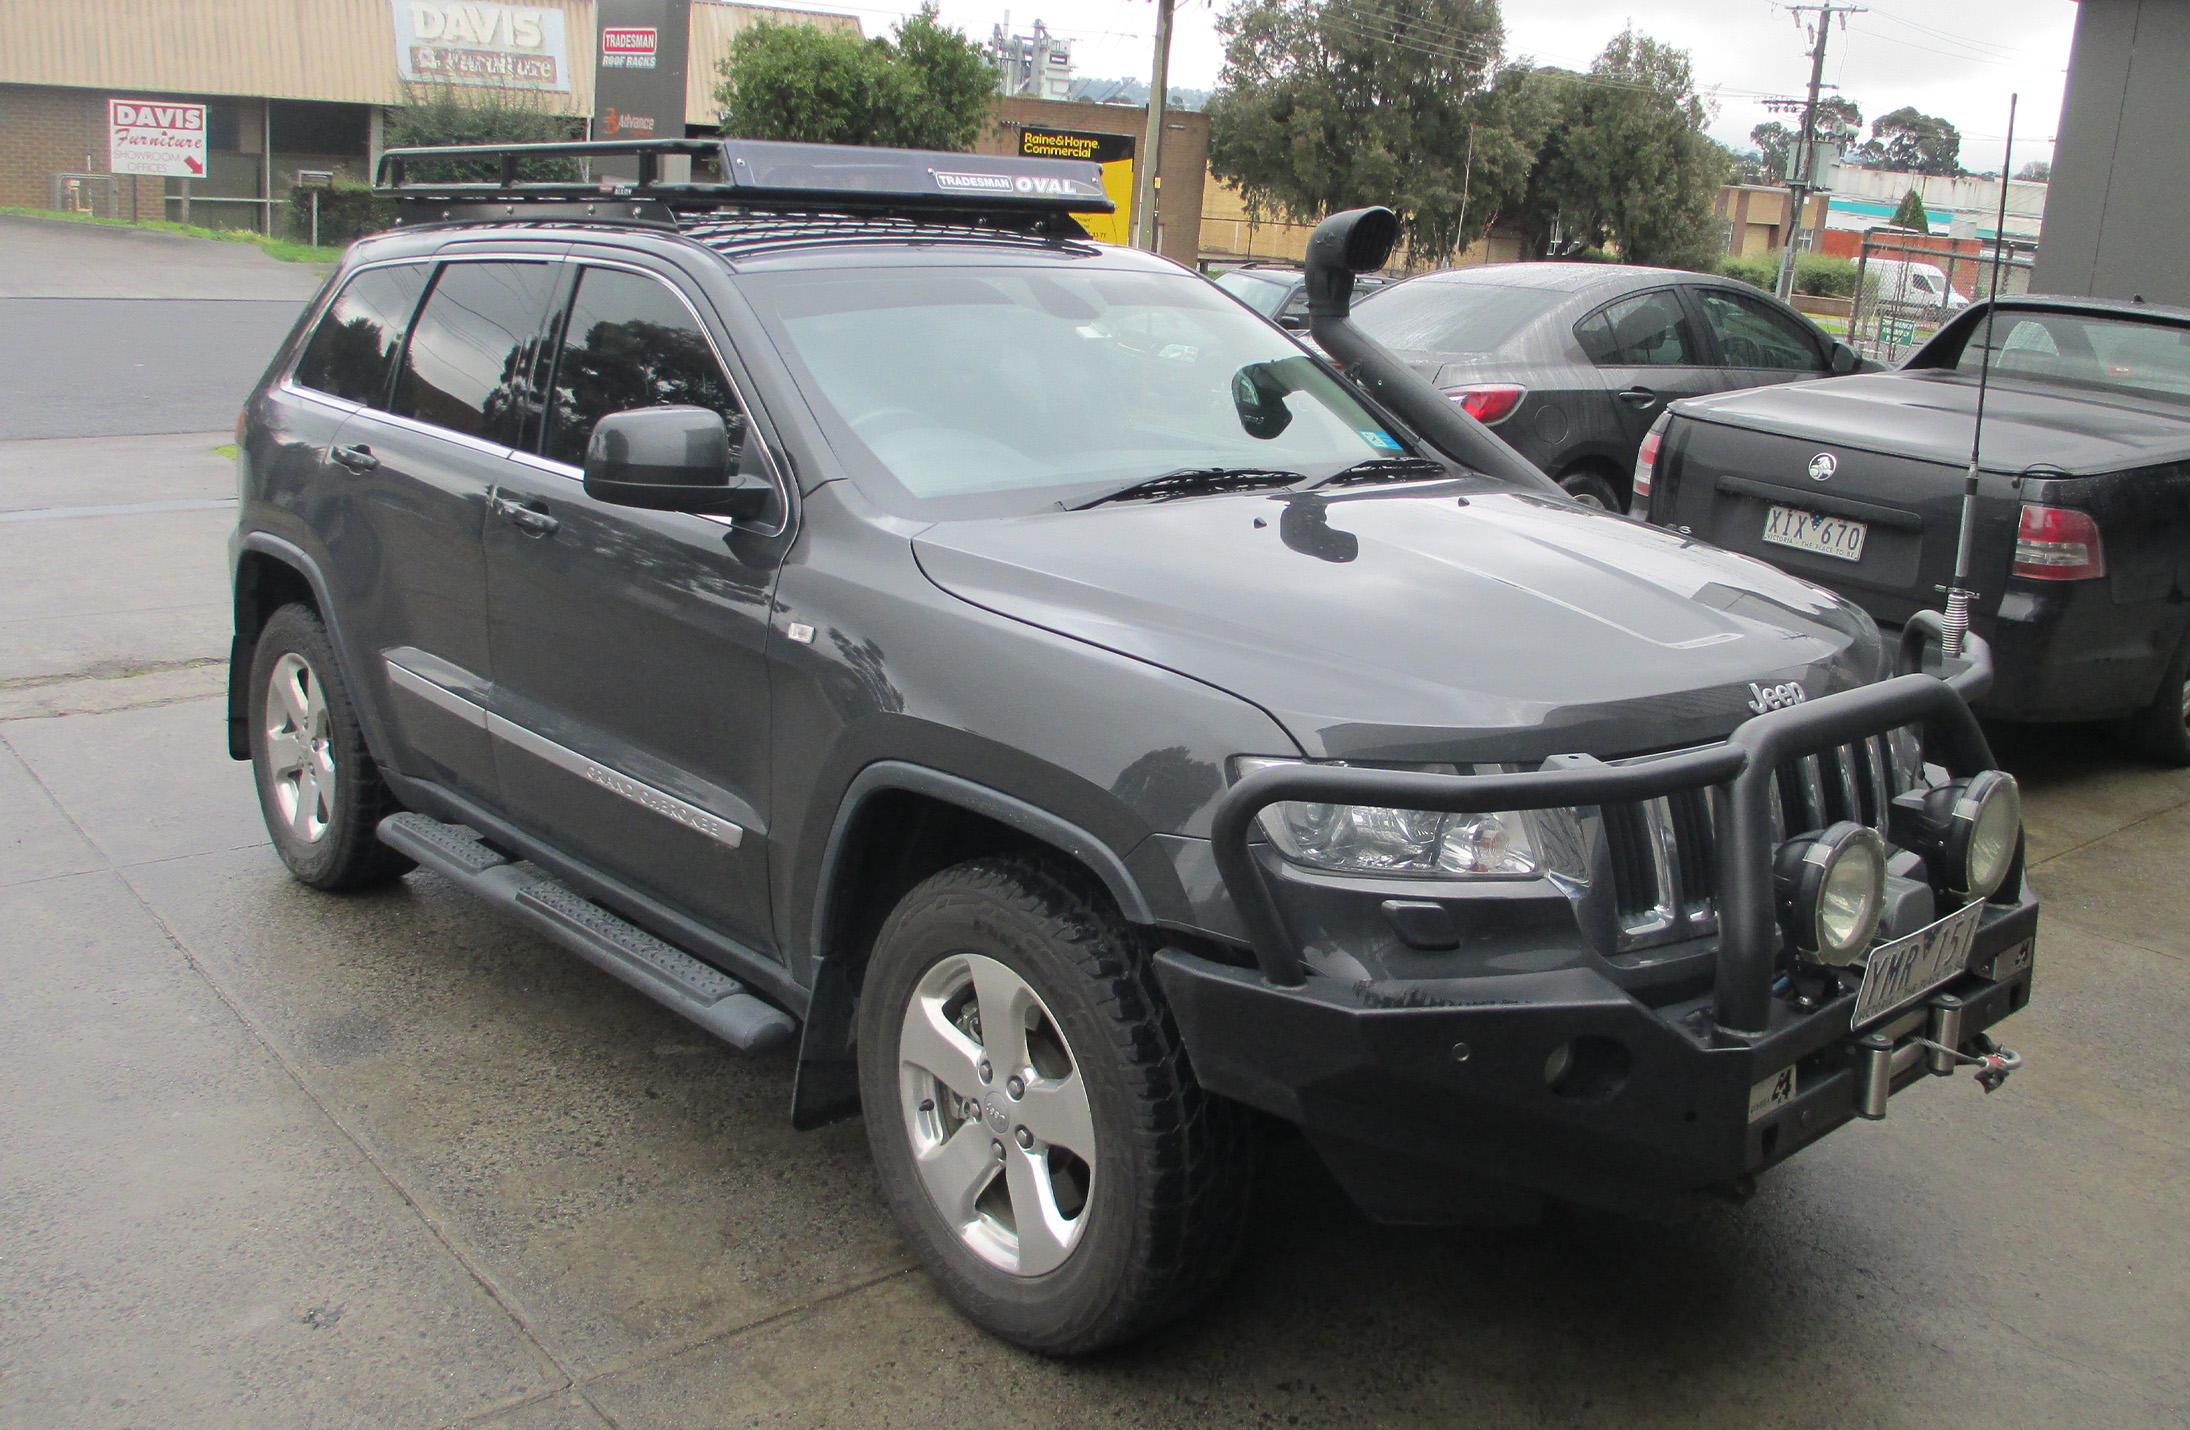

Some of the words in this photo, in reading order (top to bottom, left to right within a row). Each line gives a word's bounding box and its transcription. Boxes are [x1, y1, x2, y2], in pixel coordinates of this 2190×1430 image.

[409, 2, 543, 48] DAVIS
[605, 33, 654, 48] TRADESMAN
[602, 55, 625, 67] ROOF
[626, 56, 656, 69] RACKS
[117, 105, 201, 129] DAVIS
[618, 113, 655, 131] Advance
[114, 128, 202, 149] Furniture
[113, 150, 180, 161] SHOWROOM
[1023, 143, 1092, 158] Commercial
[127, 162, 168, 173] OFFICES
[938, 175, 1011, 189] TRADESMAN
[1015, 176, 1077, 195] OVAL
[1768, 509, 1808, 540] XIX
[1821, 522, 1860, 550] 670
[1767, 533, 1794, 544] VICTORIA
[1801, 540, 1813, 548] THE
[1815, 543, 1833, 553] PLACE
[1748, 681, 1806, 714] Jeep
[586, 765, 633, 797] GRAND
[639, 790, 720, 837] CHEROKEE
[1865, 943, 1921, 1006] YMR
